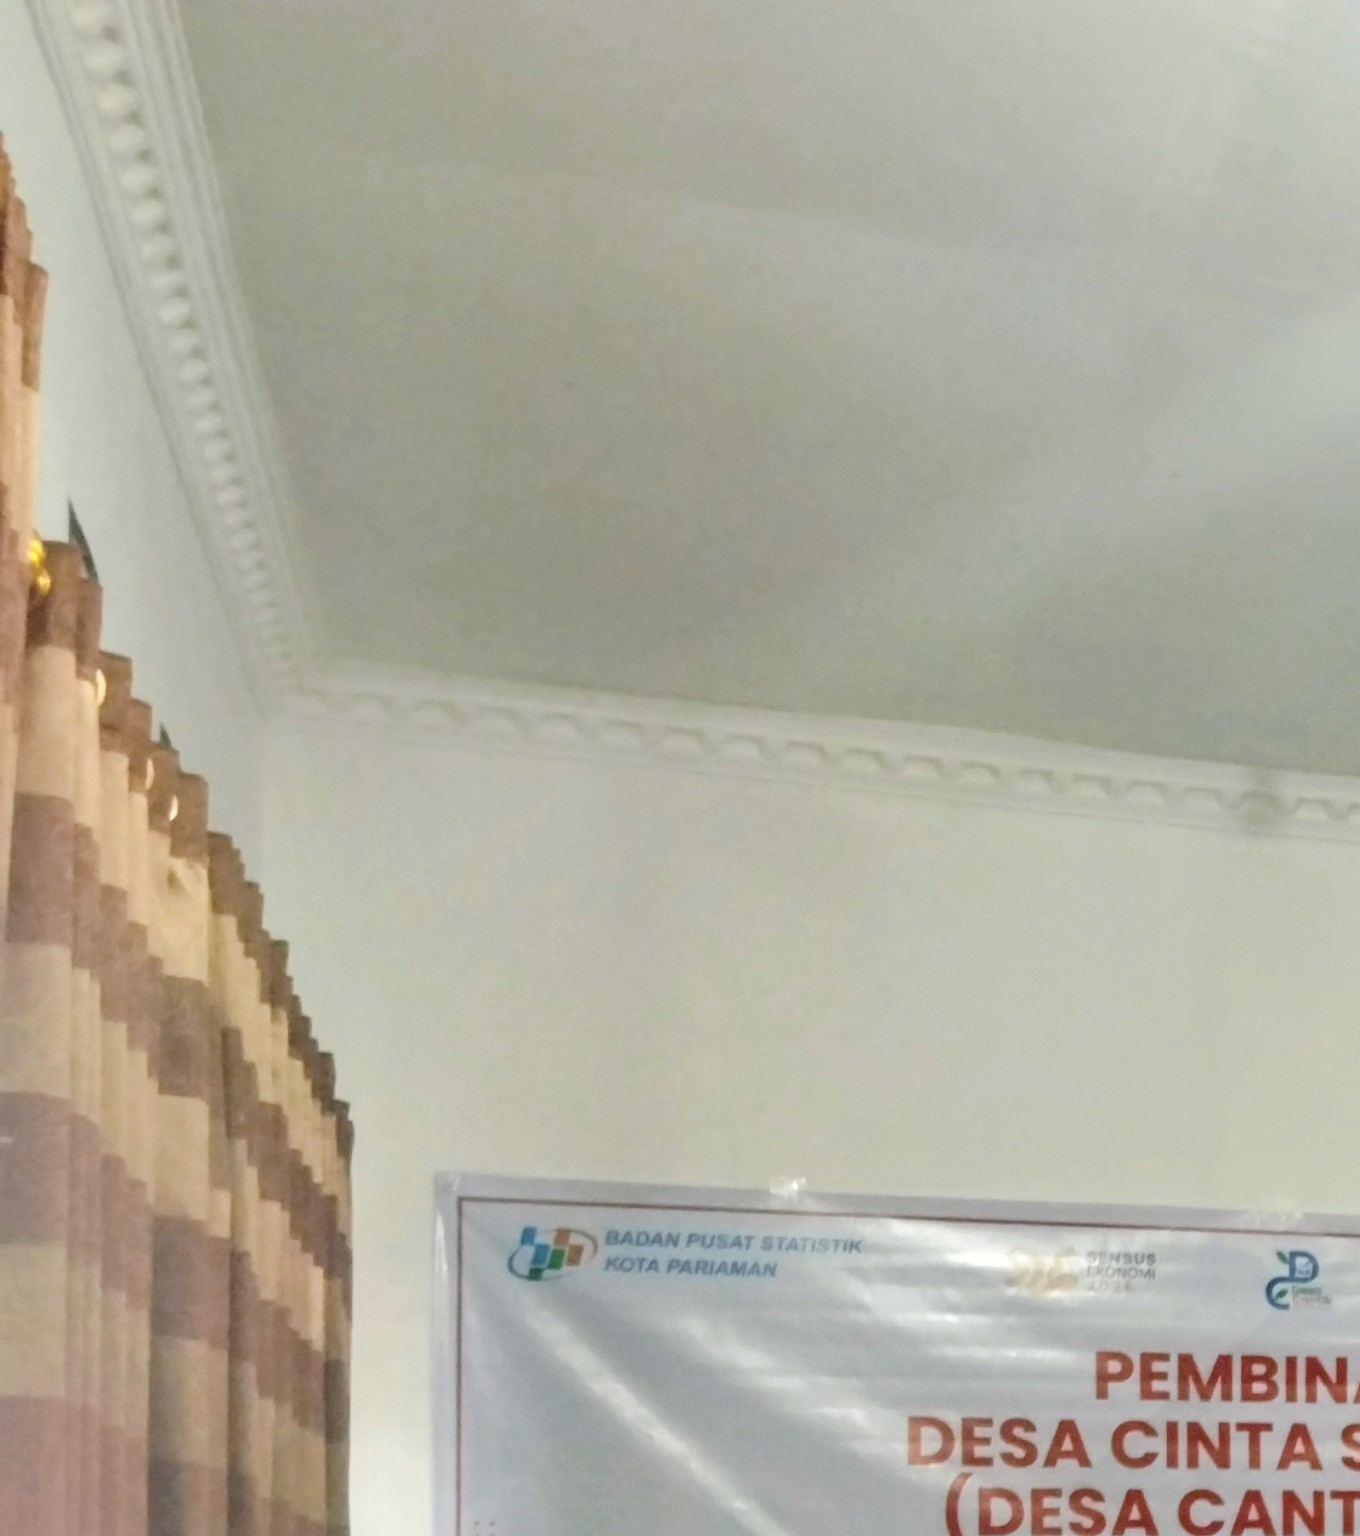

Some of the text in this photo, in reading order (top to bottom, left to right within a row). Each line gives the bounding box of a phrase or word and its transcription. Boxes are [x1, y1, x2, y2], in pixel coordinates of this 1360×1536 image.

[605, 1230, 863, 1254] BADAN PUSAT STATISTIK
[604, 1258, 778, 1278] KOTA PARIAMAN
[906, 1416, 1093, 1470] DESA
[1110, 1419, 1324, 1472] CINTA
